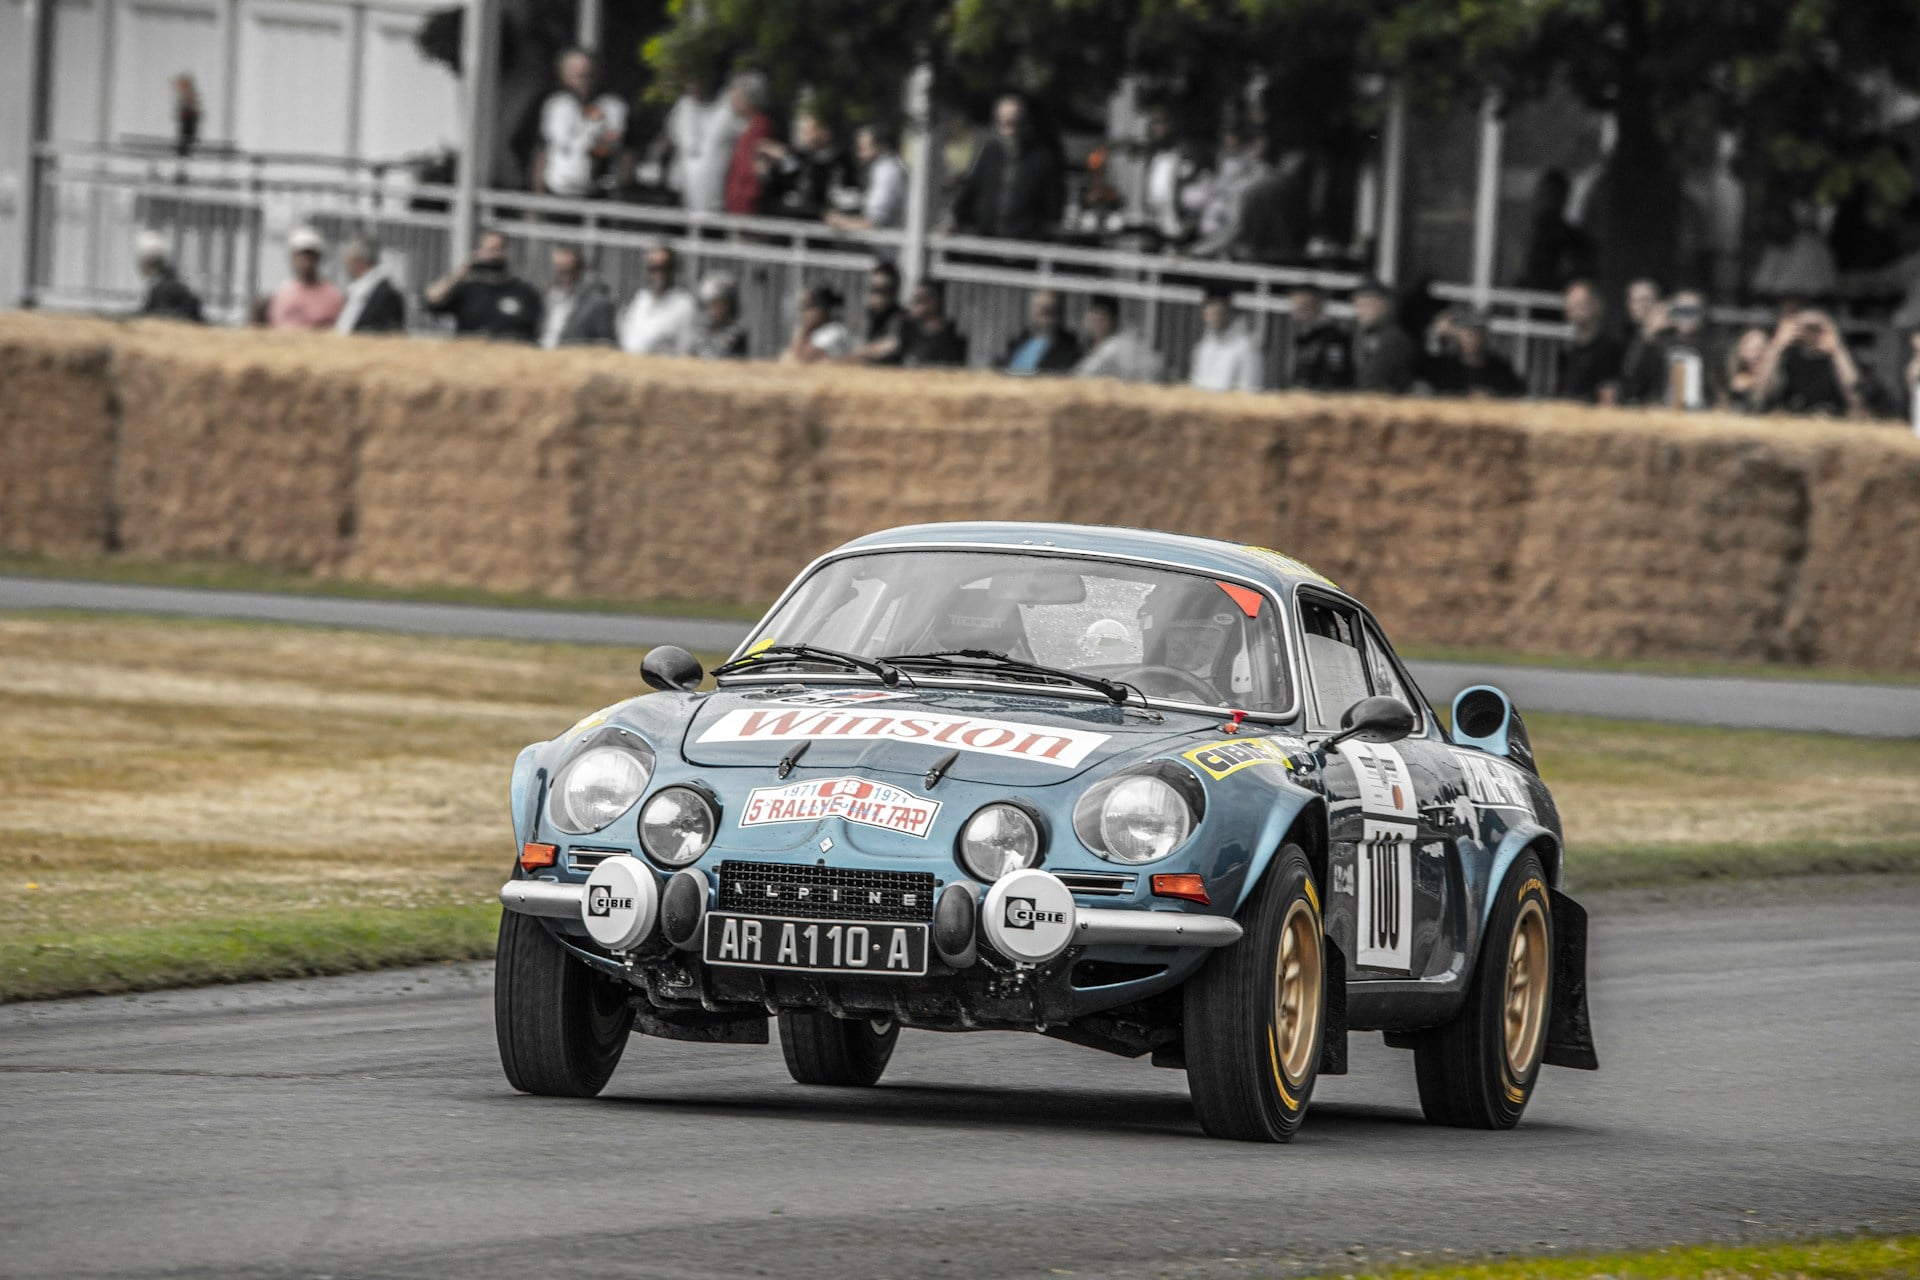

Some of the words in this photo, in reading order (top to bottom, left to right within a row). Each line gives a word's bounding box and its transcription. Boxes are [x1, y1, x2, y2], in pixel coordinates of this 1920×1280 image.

[738, 709, 1073, 761] Winston
[768, 796, 844, 820] RALLYE
[783, 784, 818, 797] 1971
[874, 787, 908, 804] 1971
[734, 882, 917, 907] ALPINE
[1366, 831, 1404, 951] 100
[718, 918, 762, 962] AR
[777, 923, 869, 968] A110
[887, 928, 910, 969] A
